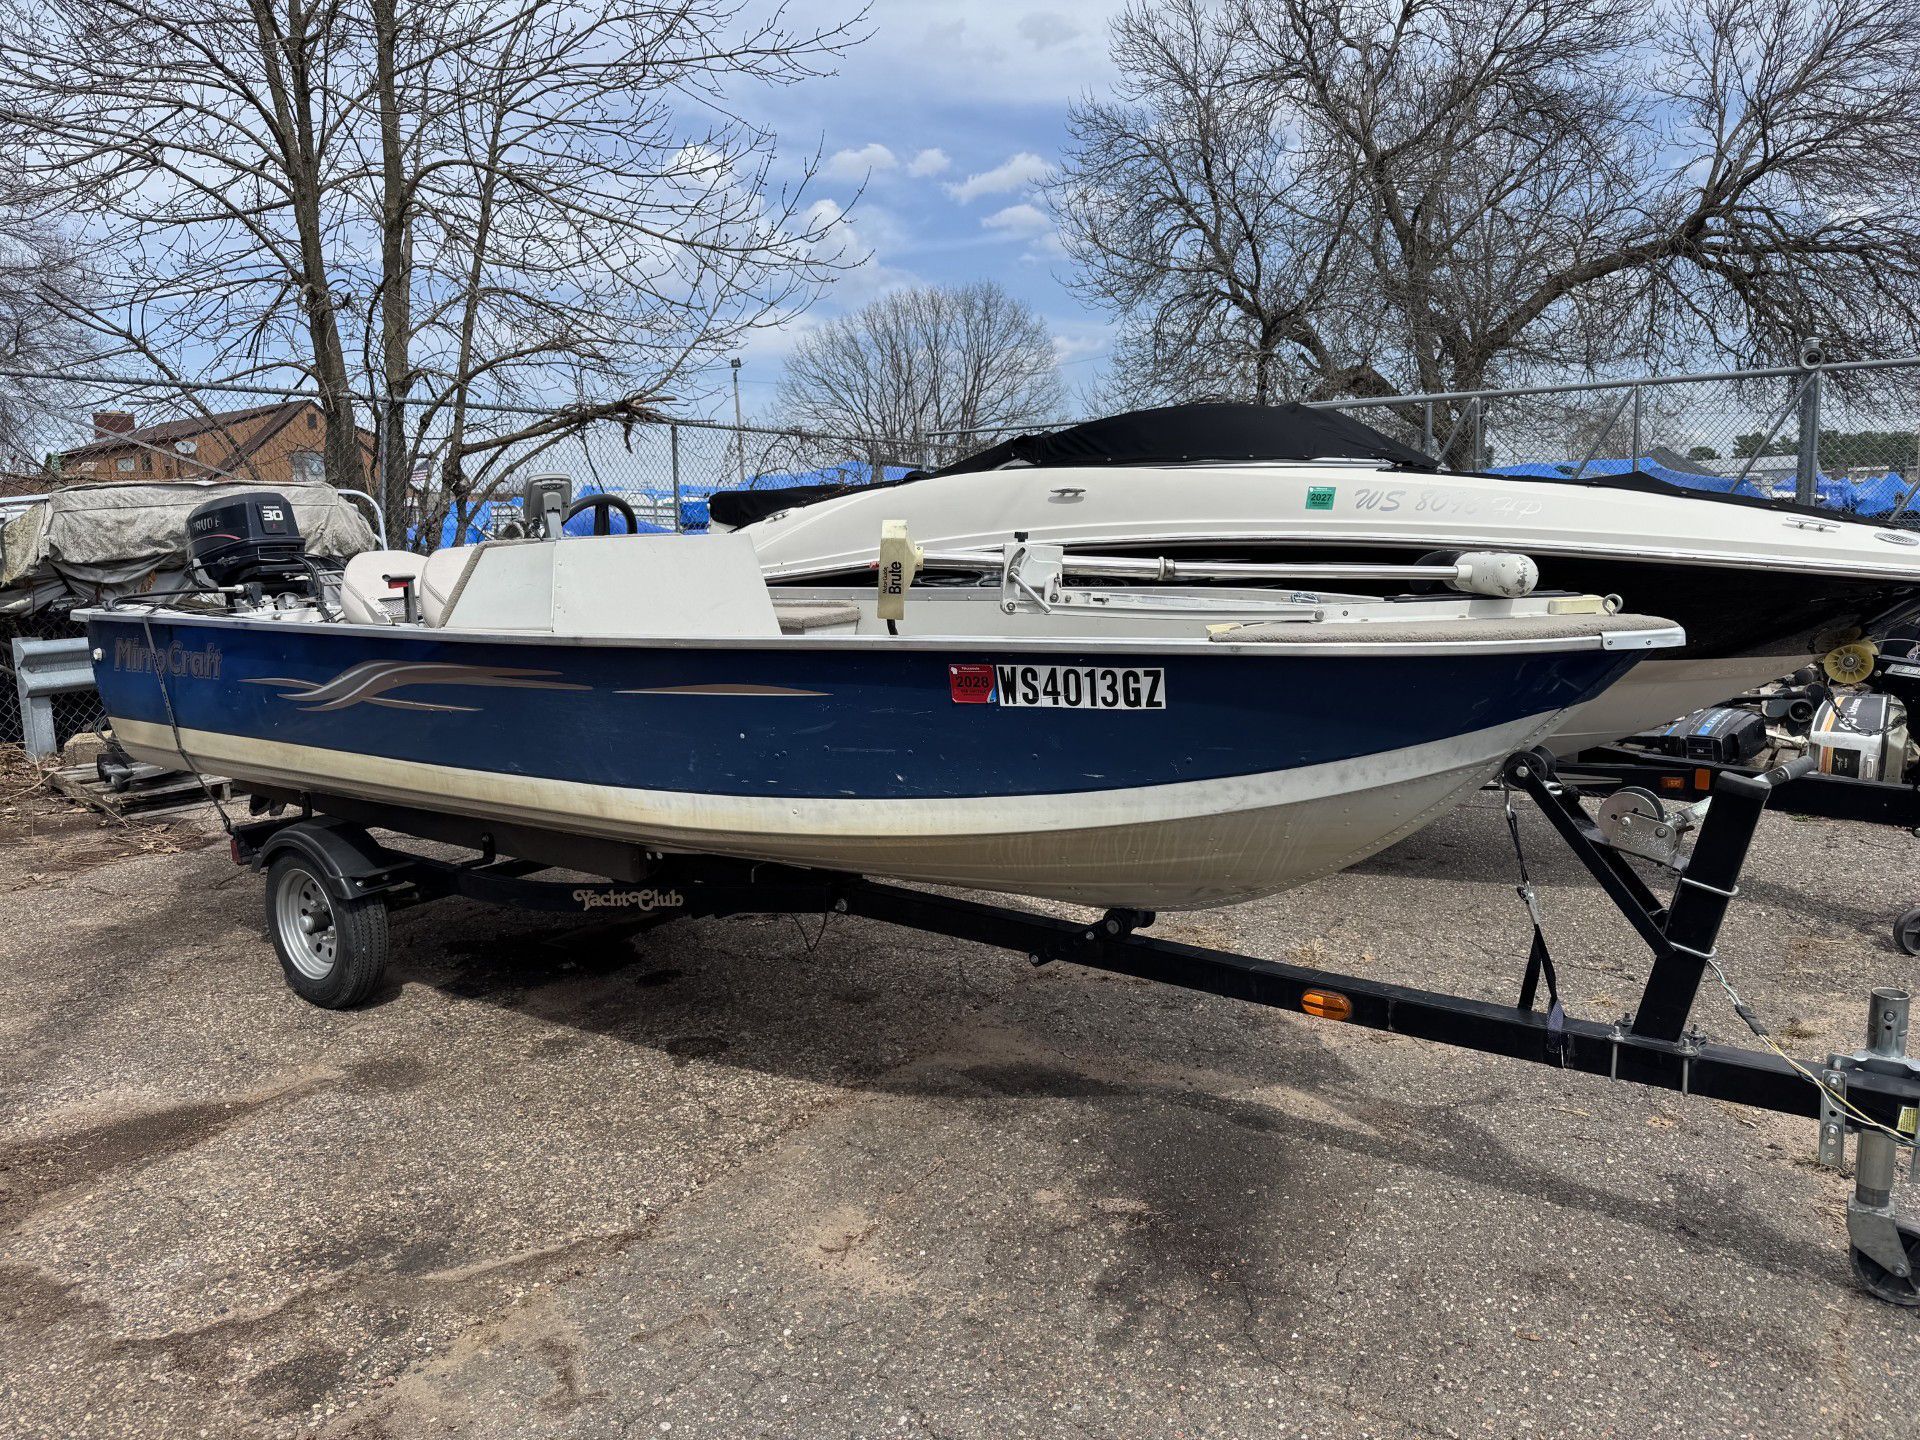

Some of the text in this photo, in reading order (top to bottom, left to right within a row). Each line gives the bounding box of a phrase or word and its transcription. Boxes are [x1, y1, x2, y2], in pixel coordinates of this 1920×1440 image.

[1311, 494, 1332, 502] 2027
[1355, 488, 1407, 512] WS
[262, 509, 284, 521] 30
[888, 561, 902, 595] Brute
[957, 676, 990, 688] 2028
[998, 666, 1163, 708] WS4013GZ
